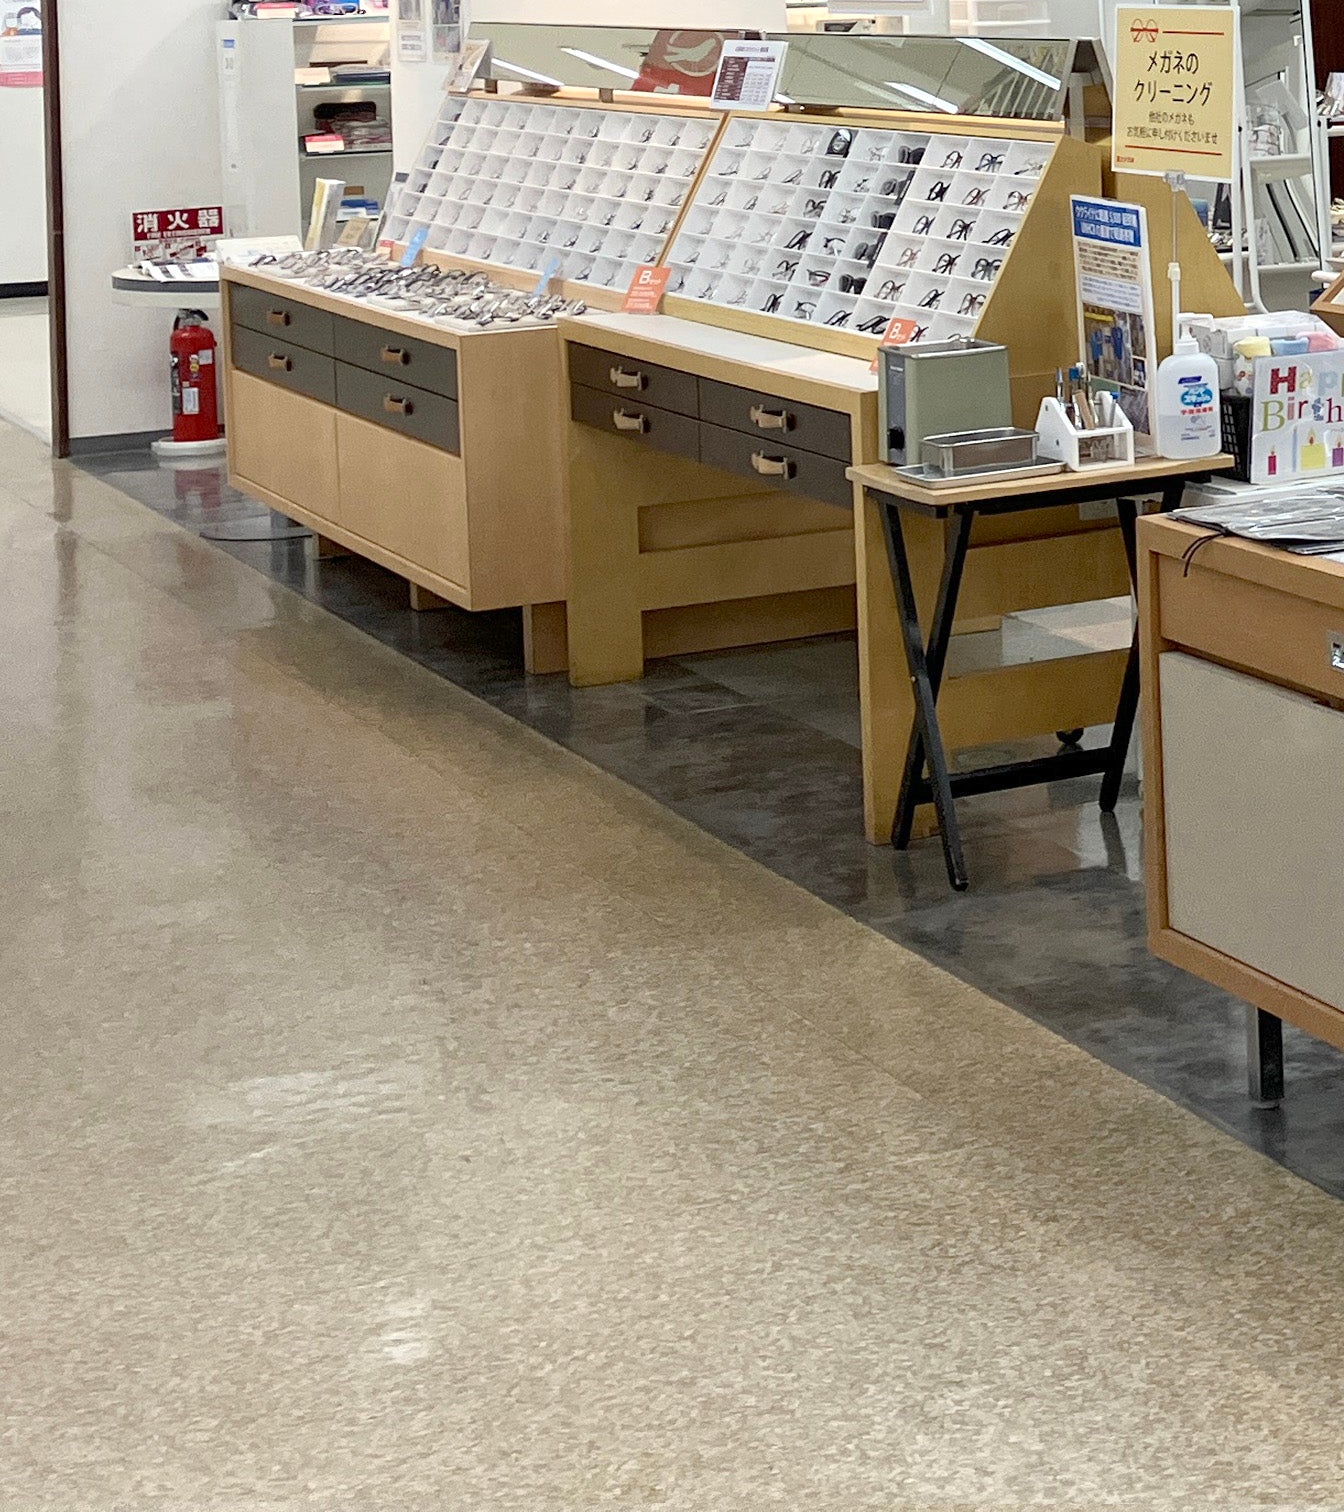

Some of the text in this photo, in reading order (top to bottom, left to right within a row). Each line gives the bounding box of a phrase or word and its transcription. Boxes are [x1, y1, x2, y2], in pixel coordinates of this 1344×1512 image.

[1147, 50, 1200, 75] メガネの
[1133, 79, 1213, 107] クリーニング
[136, 209, 220, 233] 消火器
